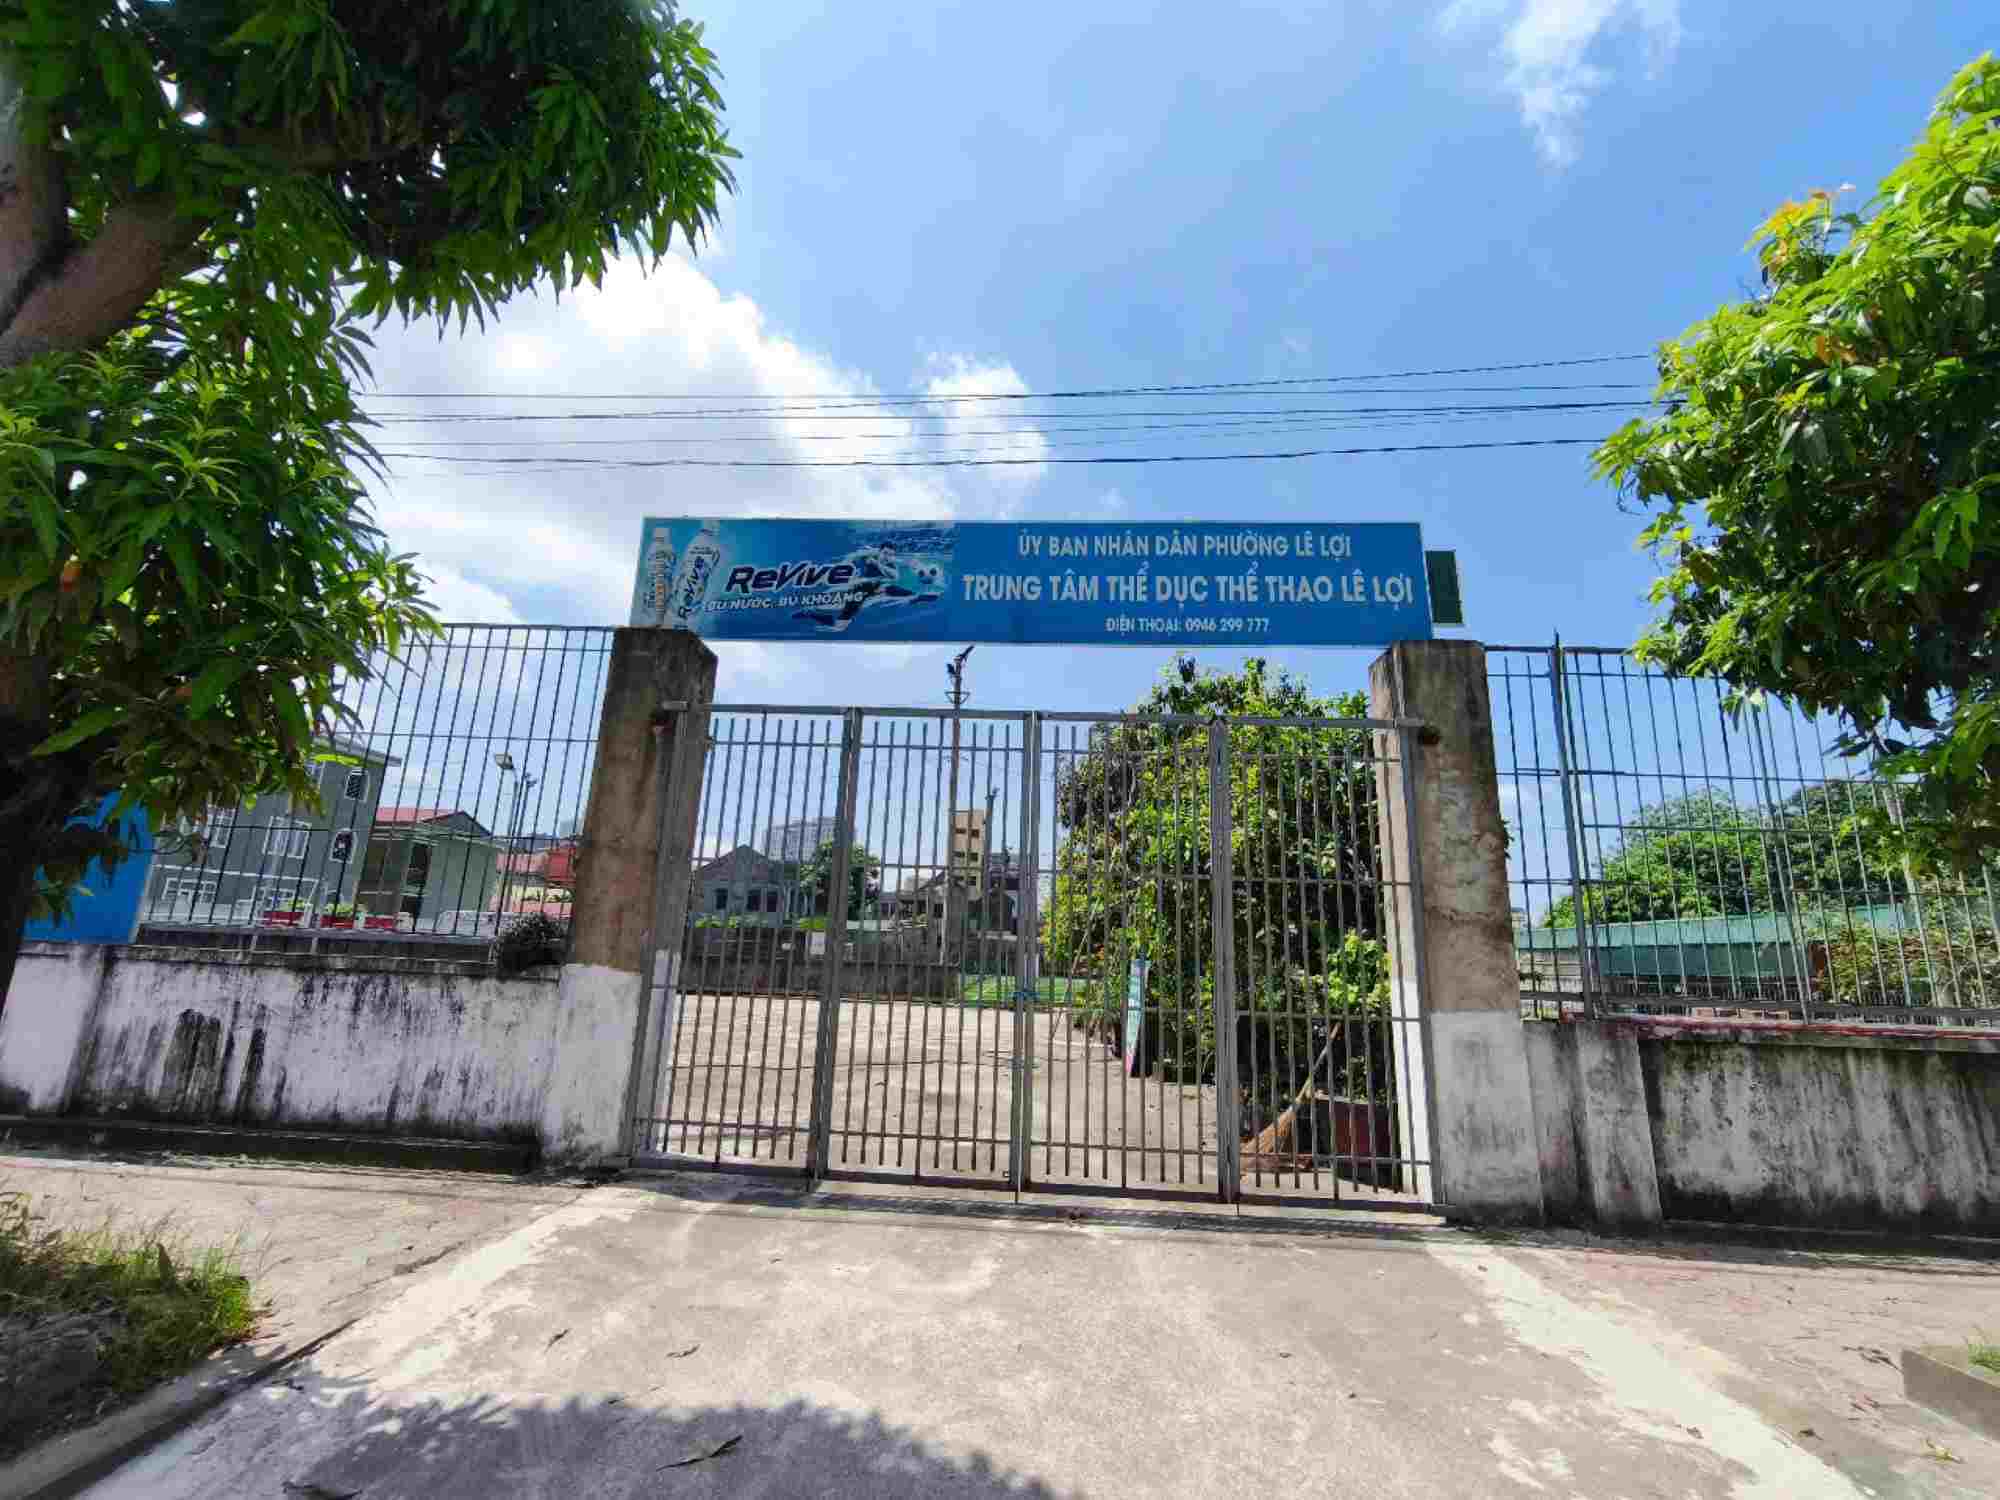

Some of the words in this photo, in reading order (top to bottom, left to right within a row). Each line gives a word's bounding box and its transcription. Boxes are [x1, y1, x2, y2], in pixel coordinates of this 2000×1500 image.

[1049, 536, 1087, 556] BAN
[1094, 529, 1150, 556] NHÂN
[1156, 529, 1197, 556] DÂN
[1204, 529, 1289, 557] PHƯỜNG
[1296, 530, 1315, 557] LÊ
[1320, 534, 1352, 562] LỢI
[962, 575, 1042, 601] TRUNG
[1050, 568, 1099, 601] TÂM
[1106, 561, 1149, 601] THỂ
[1155, 575, 1208, 609] DỤC
[1216, 561, 1259, 602] THỂ
[1265, 575, 1334, 602] THAO
[1341, 569, 1366, 602] LÊ
[1373, 573, 1414, 611] LỢI
[1219, 617, 1244, 633] 299
[1247, 617, 1270, 633] 777
